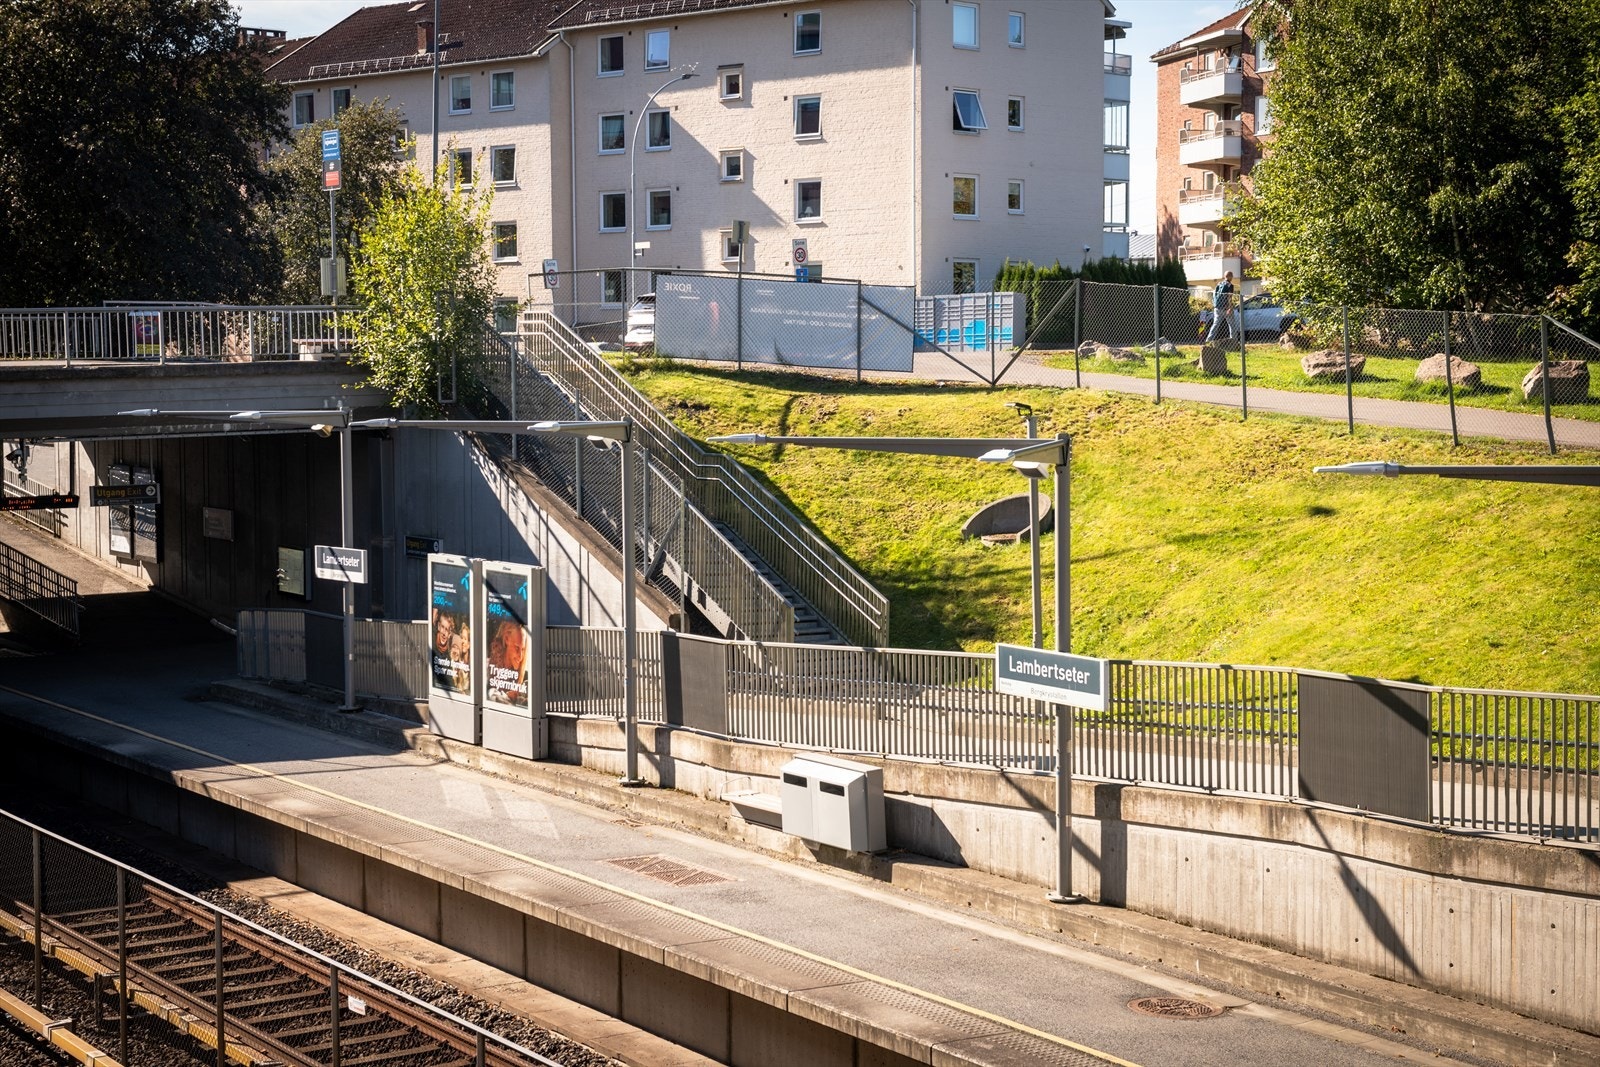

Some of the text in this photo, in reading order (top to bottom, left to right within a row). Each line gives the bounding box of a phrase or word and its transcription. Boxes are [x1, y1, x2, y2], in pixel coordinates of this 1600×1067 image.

[797, 250, 804, 259] 30
[96, 487, 142, 498] Utgang Exit
[489, 664, 519, 680] Tryggere
[1009, 655, 1091, 685] Lambertseter
[489, 677, 528, 694] skjermbruk
